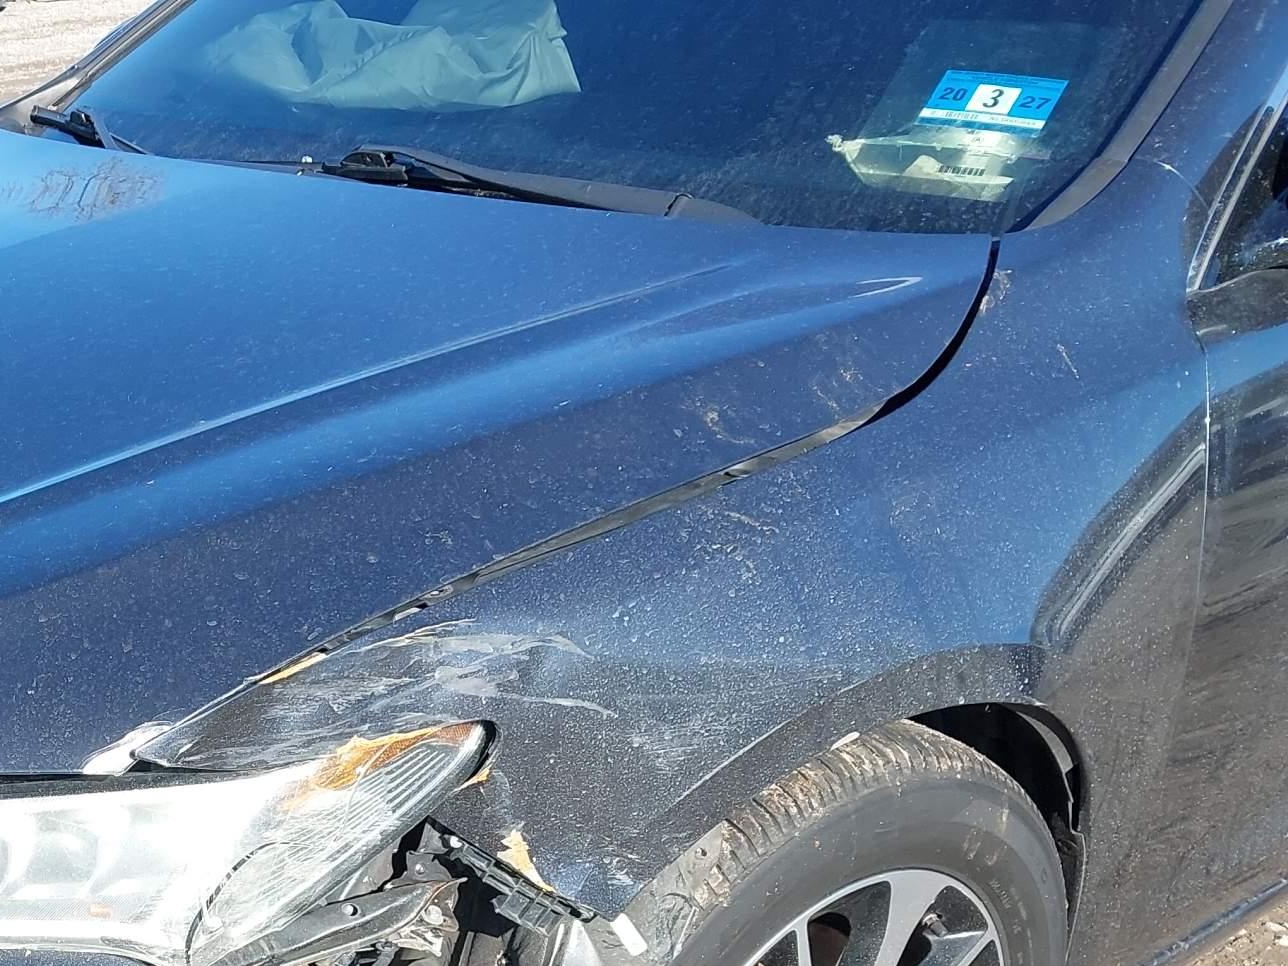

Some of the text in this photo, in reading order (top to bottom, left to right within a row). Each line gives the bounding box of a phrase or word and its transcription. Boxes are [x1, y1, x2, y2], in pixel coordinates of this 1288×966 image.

[937, 87, 1052, 110] 20 3 27
